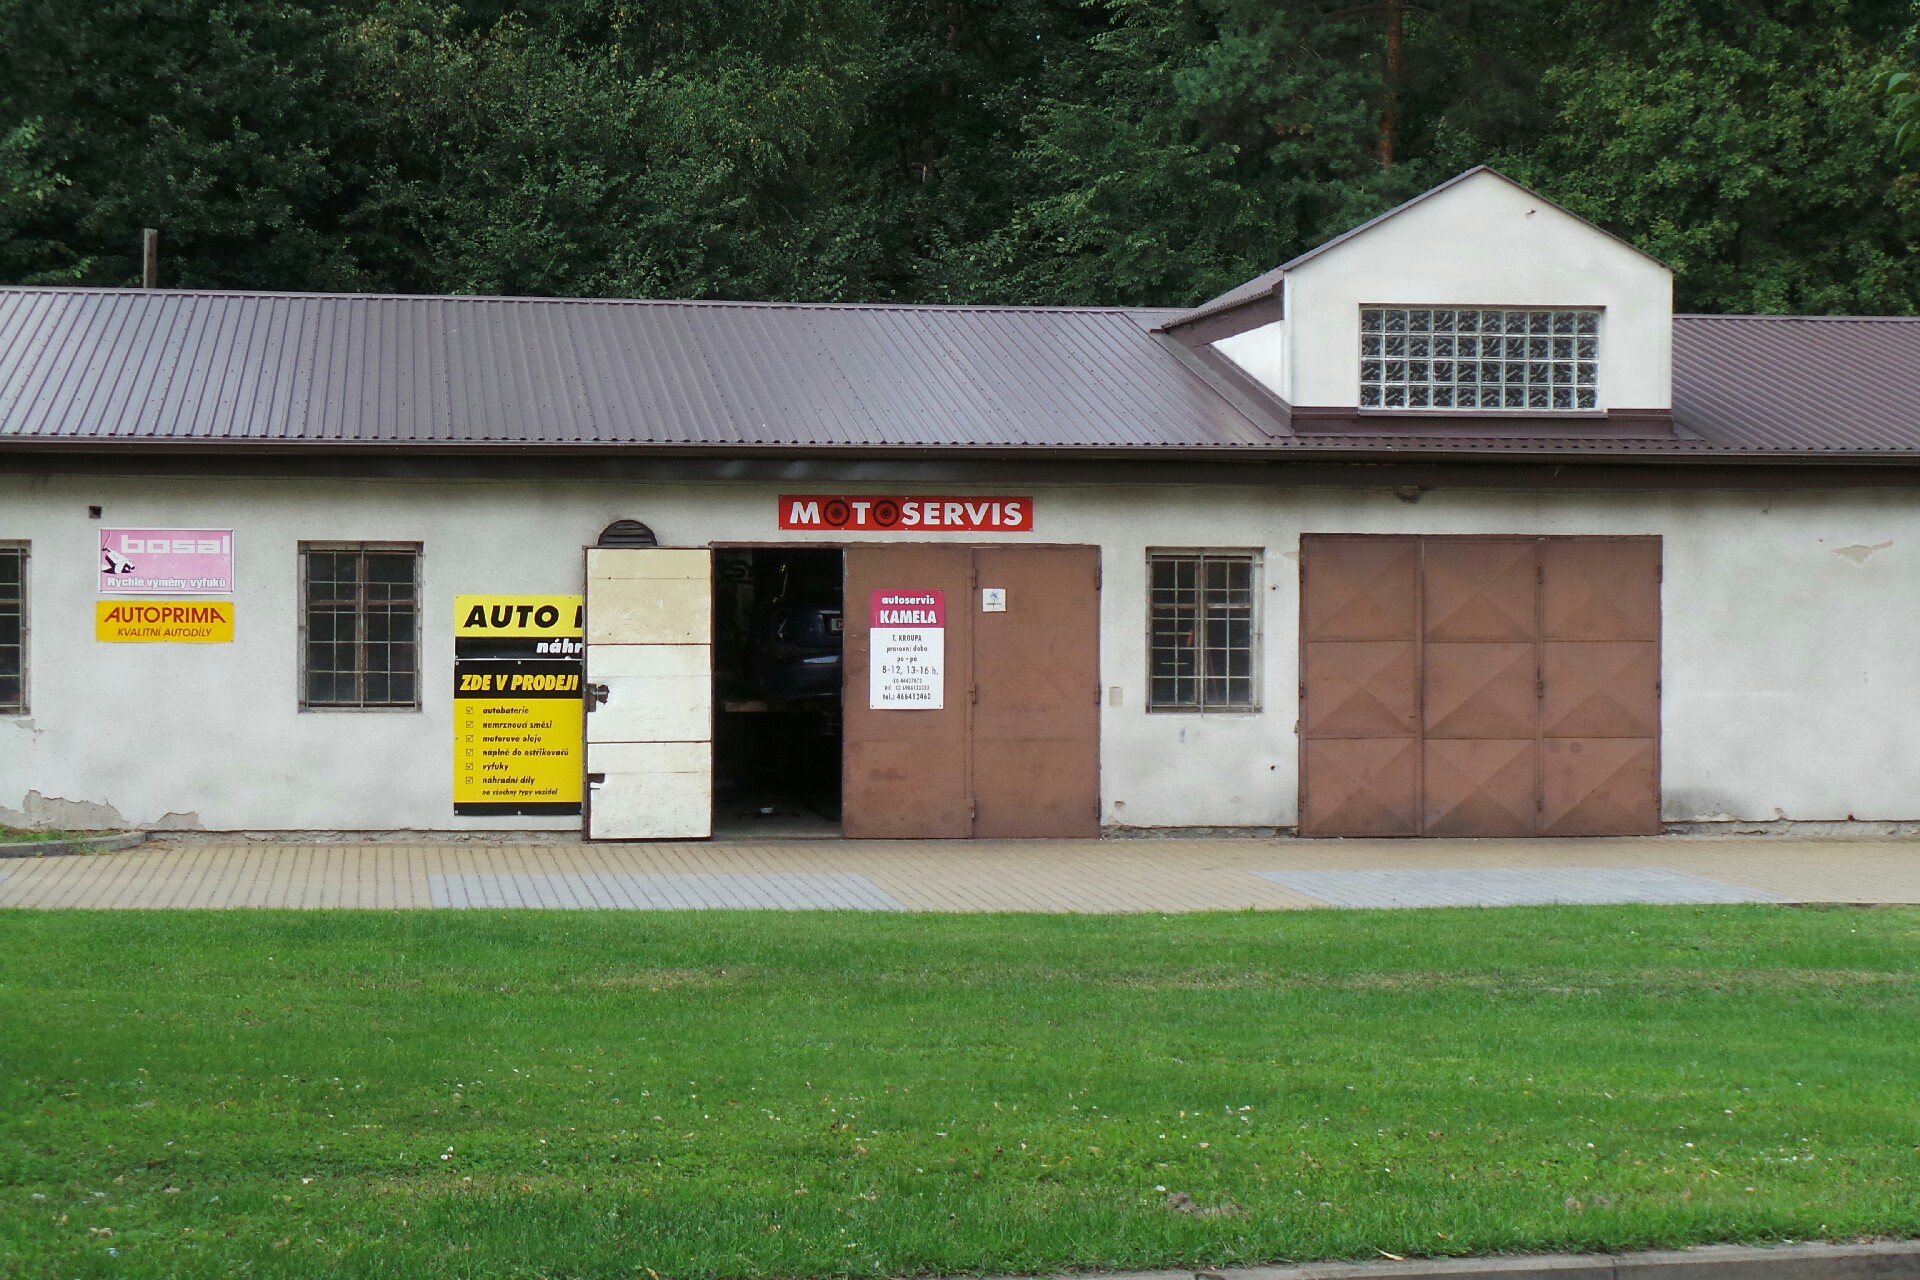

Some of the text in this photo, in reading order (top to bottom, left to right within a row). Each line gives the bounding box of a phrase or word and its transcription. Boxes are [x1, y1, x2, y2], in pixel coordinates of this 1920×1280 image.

[789, 499, 1023, 527] MOTOSERVIS
[120, 534, 230, 554] bosal
[107, 577, 226, 589] Rychlé výměny výfuků
[881, 595, 935, 605] autoservis
[104, 606, 227, 623] AUTOPRIMA
[463, 605, 560, 628] AUTO
[879, 610, 937, 624] KAMELA
[117, 626, 213, 637] KVALITNÍ AUTODÍLY
[882, 666, 903, 676] 8-12,
[907, 666, 929, 675] 13-16
[459, 675, 579, 691] ZDE V PRODEJI
[483, 706, 529, 714] autobaterie
[483, 720, 528, 729] nemrznoucí
[483, 734, 542, 743] motorové oleje
[512, 748, 522, 756] do
[524, 748, 569, 756] ostřikovačů
[483, 762, 509, 771] výfuky
[482, 776, 536, 785] náhradní díly
[492, 788, 517, 796] všechny
